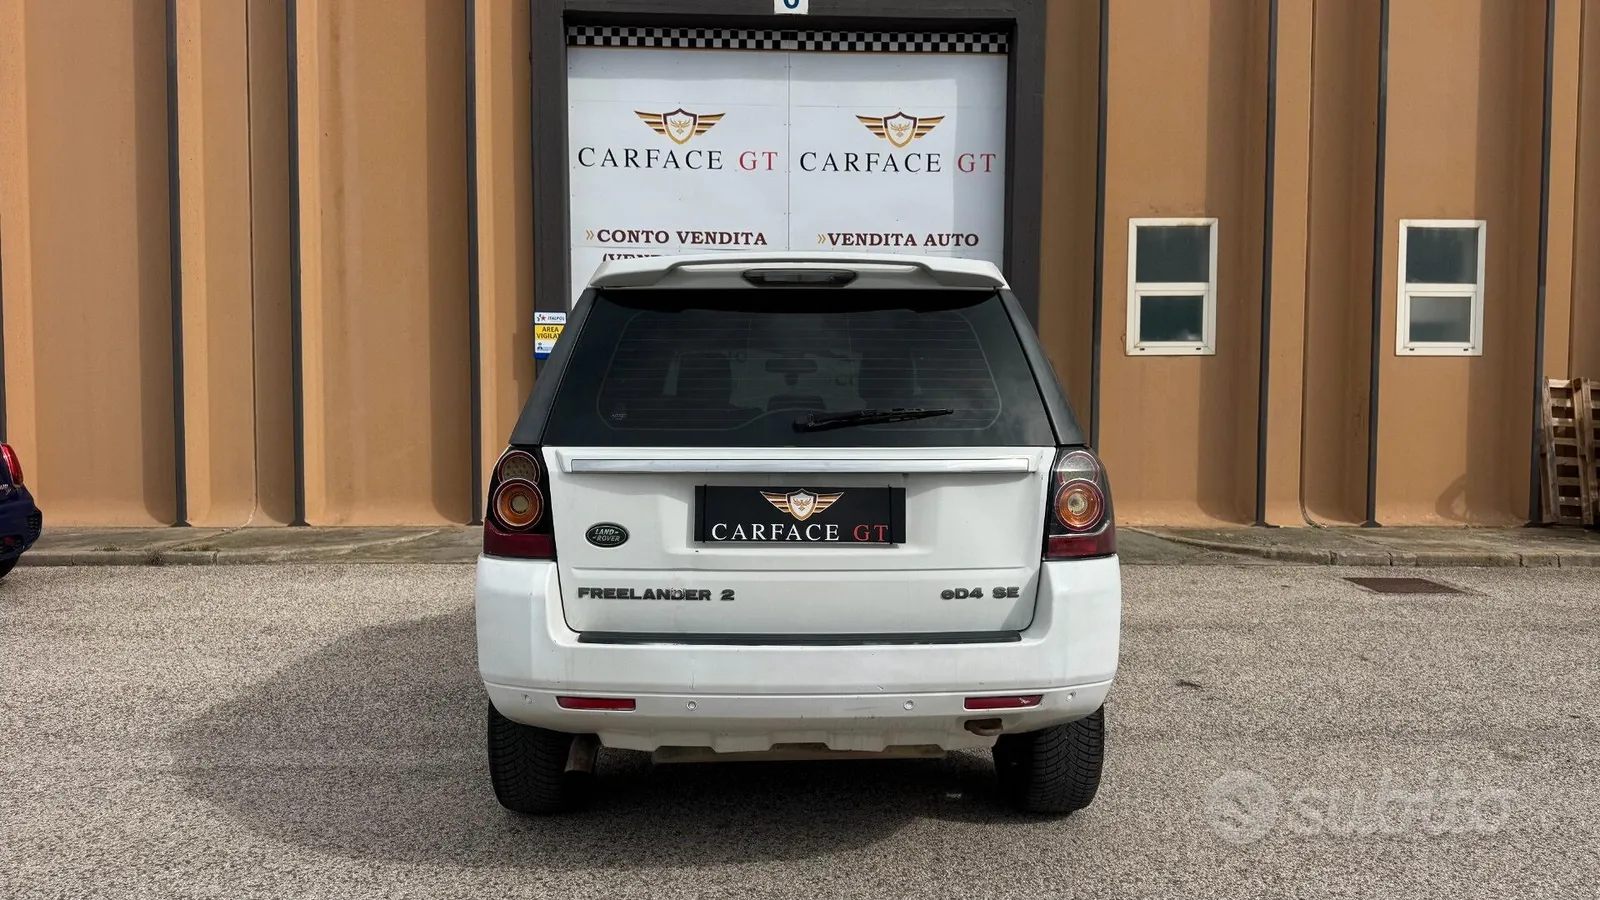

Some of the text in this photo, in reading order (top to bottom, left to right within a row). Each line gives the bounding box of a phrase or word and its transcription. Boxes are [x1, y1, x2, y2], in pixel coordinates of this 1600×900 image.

[578, 147, 778, 171] CARFACE GT
[800, 152, 997, 173] CARFACE GT
[597, 229, 768, 246] CONTO VENDITA
[827, 233, 979, 247] VENDITA AUTO
[711, 523, 889, 542] CARFACE GT
[577, 587, 735, 601] FREELANDER 2
[940, 586, 1020, 600] eD4 SE
